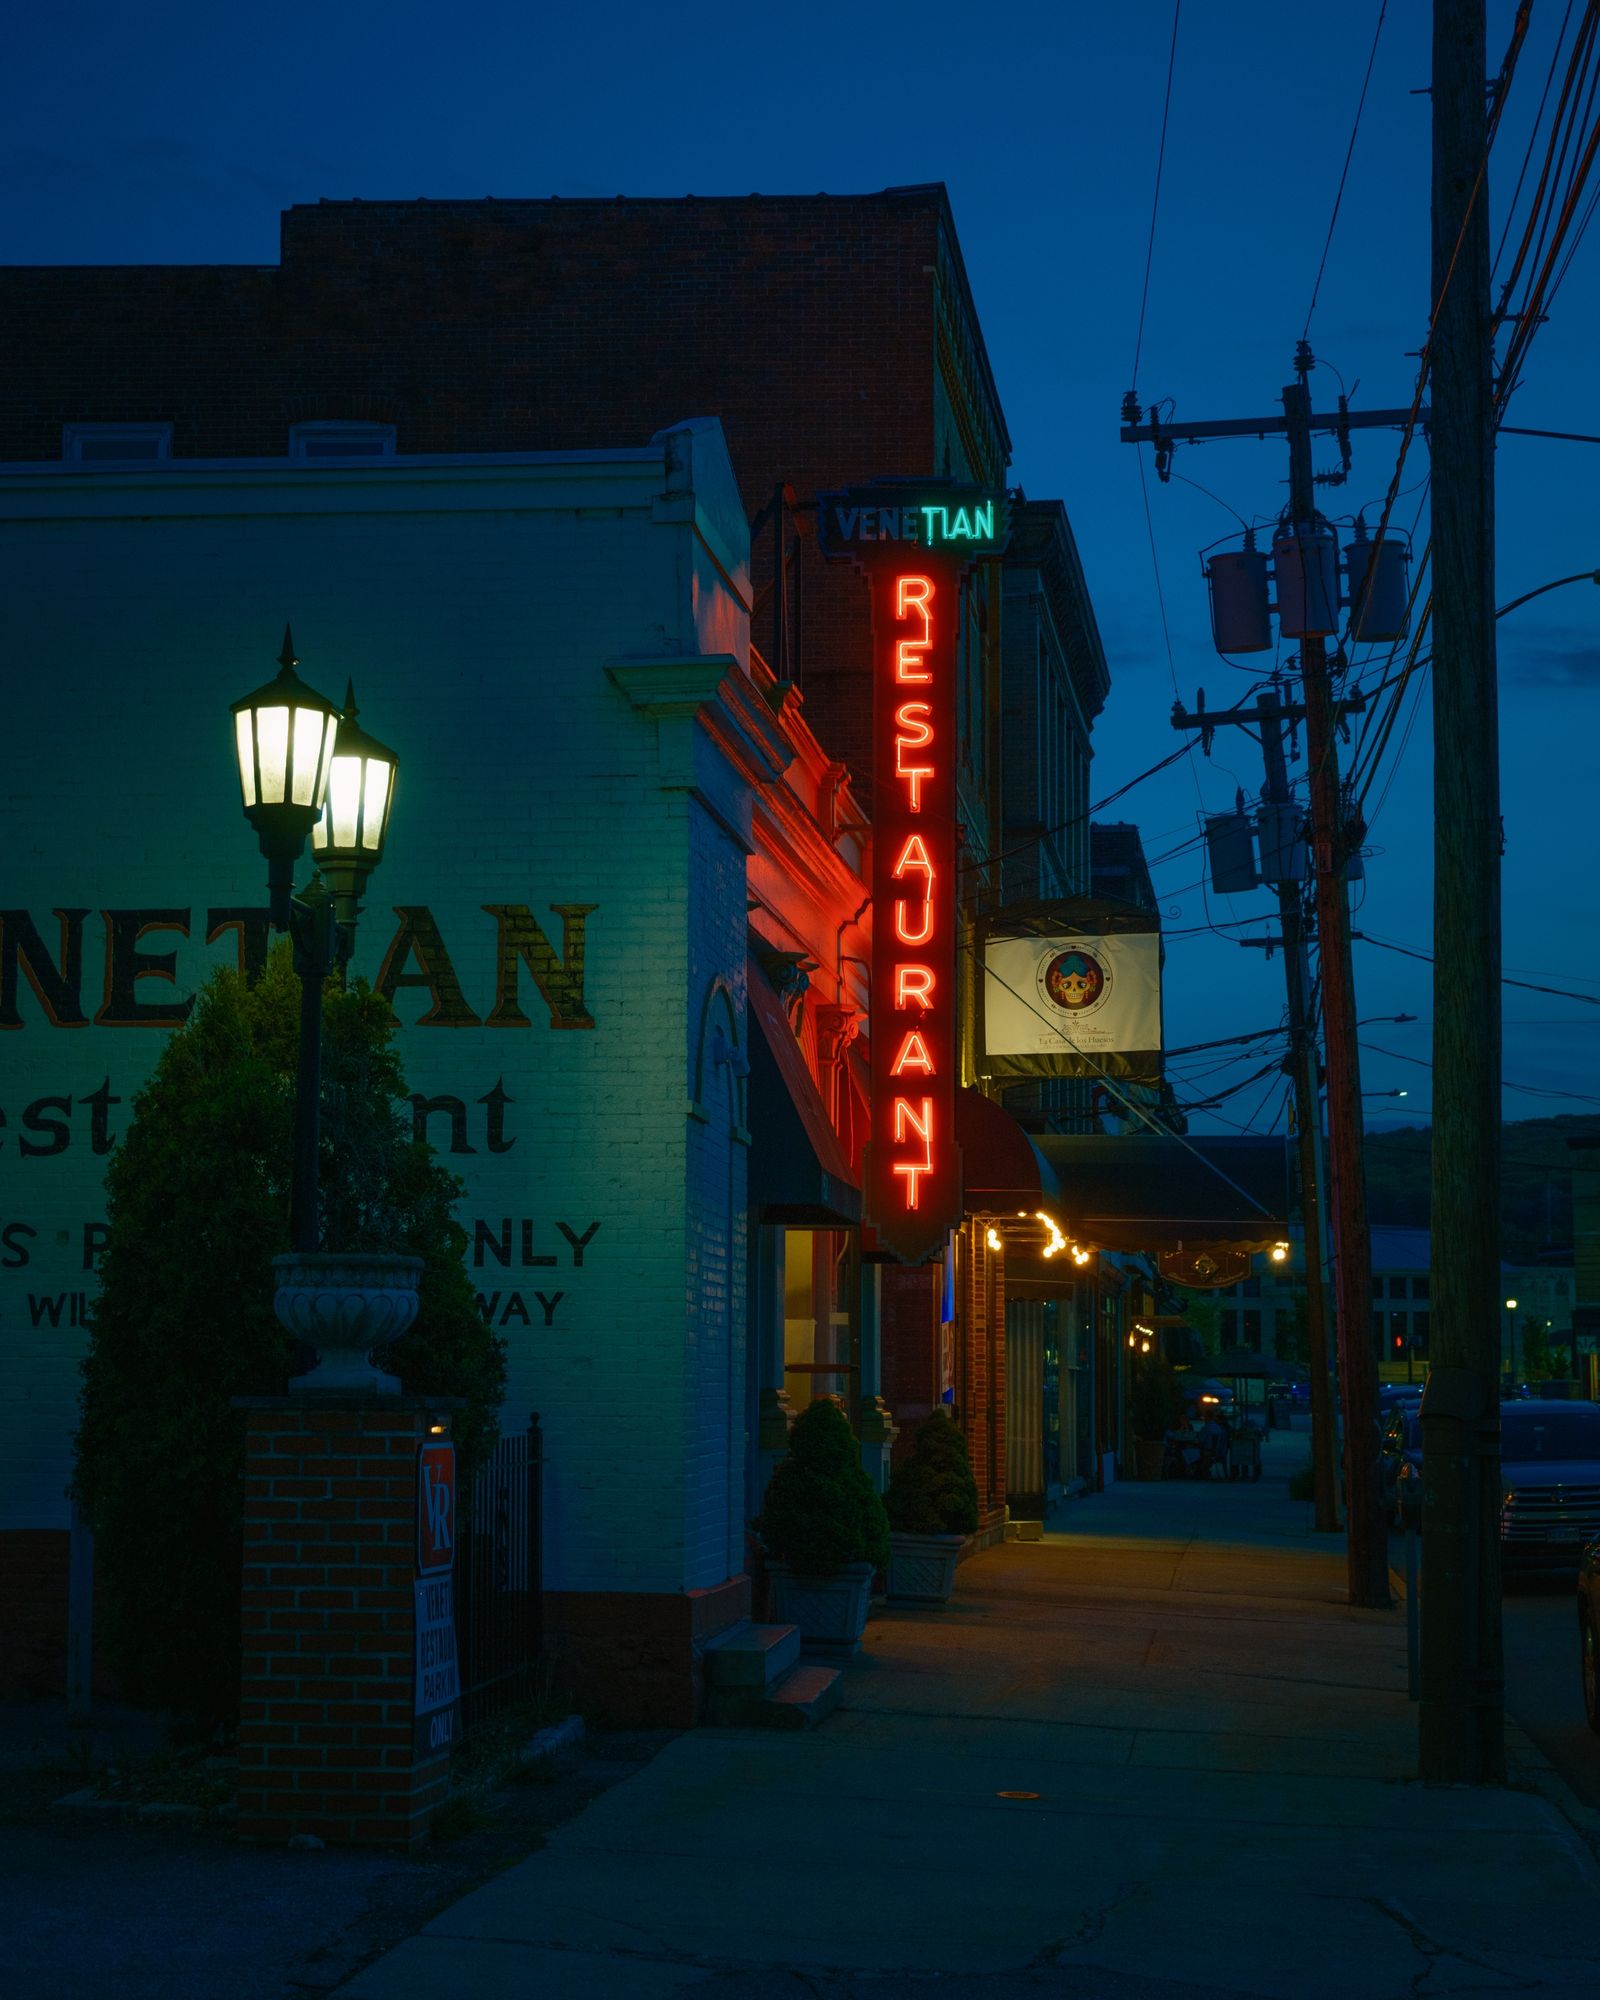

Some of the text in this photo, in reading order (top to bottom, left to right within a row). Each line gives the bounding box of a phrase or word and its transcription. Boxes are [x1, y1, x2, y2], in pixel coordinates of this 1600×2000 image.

[835, 503, 994, 541] VENETIAN
[890, 574, 937, 1211] RESTAURANT
[430, 1708, 455, 1749] ONLY
